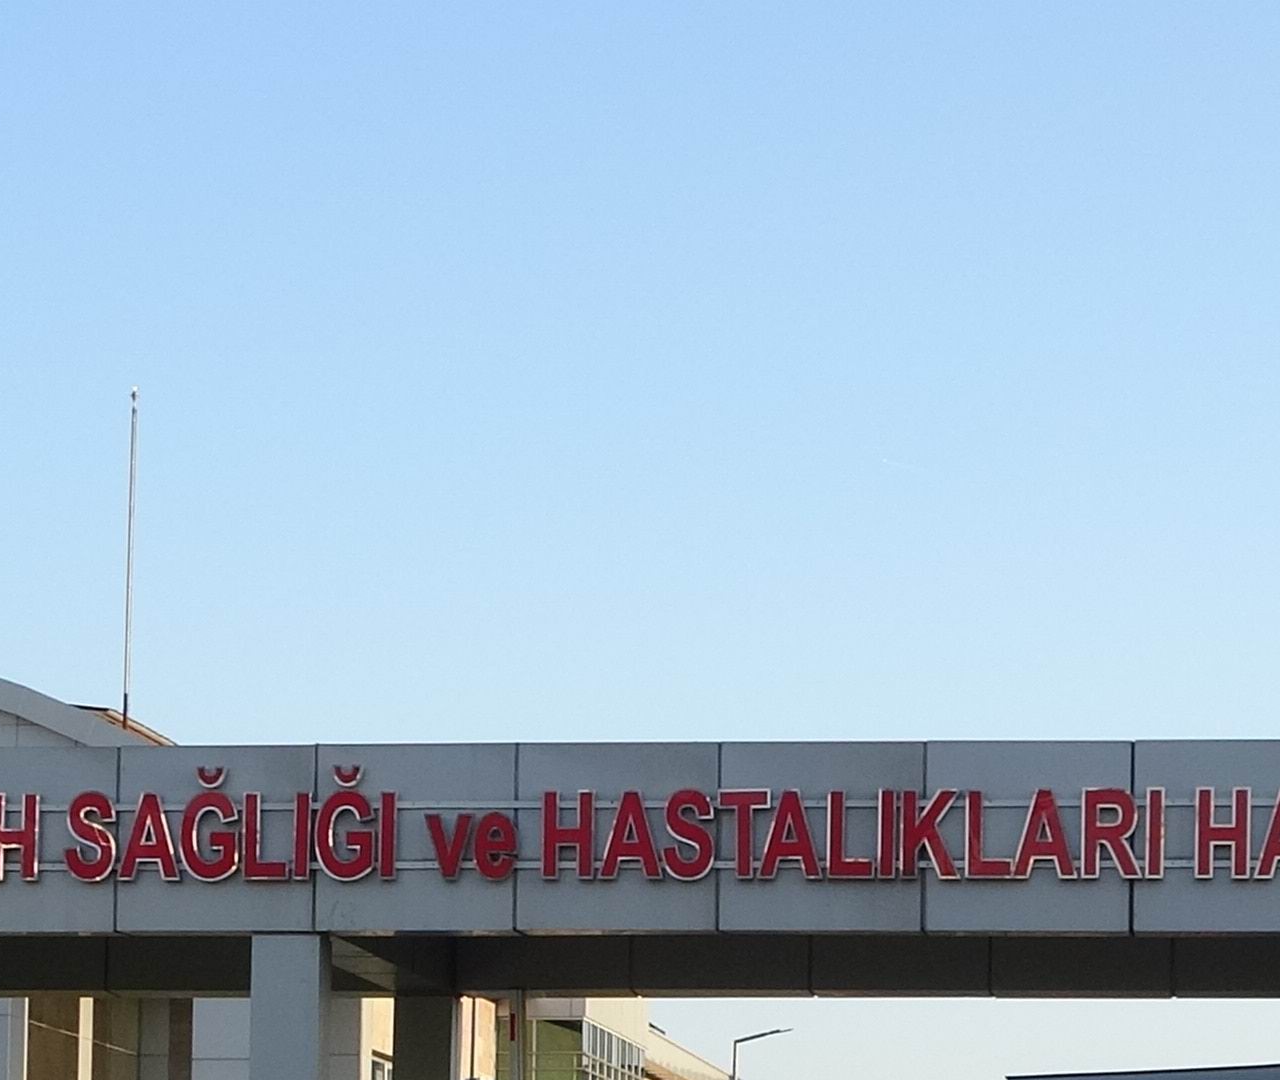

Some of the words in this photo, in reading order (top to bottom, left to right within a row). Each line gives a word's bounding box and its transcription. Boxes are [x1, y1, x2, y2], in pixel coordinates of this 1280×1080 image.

[64, 766, 398, 883] SAĞLIĞI
[424, 810, 519, 881] ve
[542, 786, 1166, 882] HASTALIKLARI
